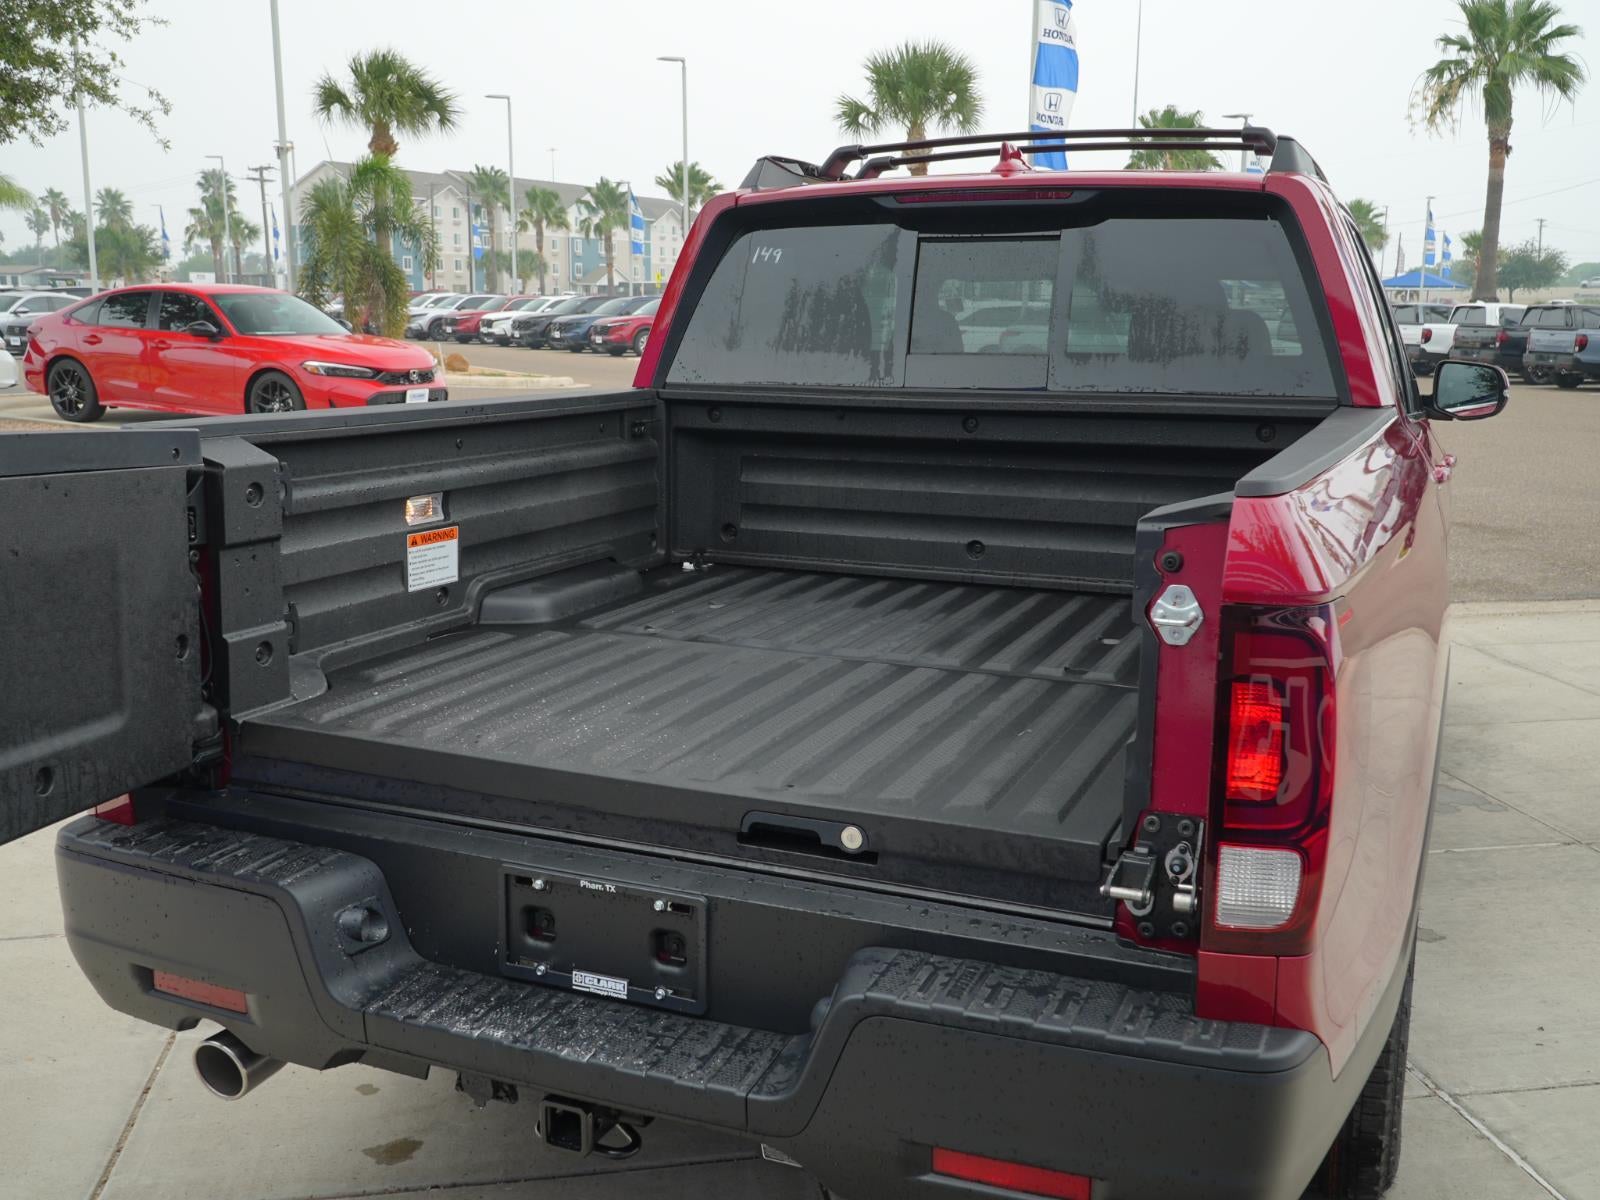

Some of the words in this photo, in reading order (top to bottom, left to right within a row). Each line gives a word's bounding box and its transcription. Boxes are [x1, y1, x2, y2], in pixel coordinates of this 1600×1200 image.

[1043, 28, 1074, 44] HONDA
[1036, 112, 1064, 126] HONDA
[752, 246, 783, 264] 149
[420, 529, 455, 544] WARNING
[605, 884, 617, 893] TX
[583, 975, 625, 992] CLARK
